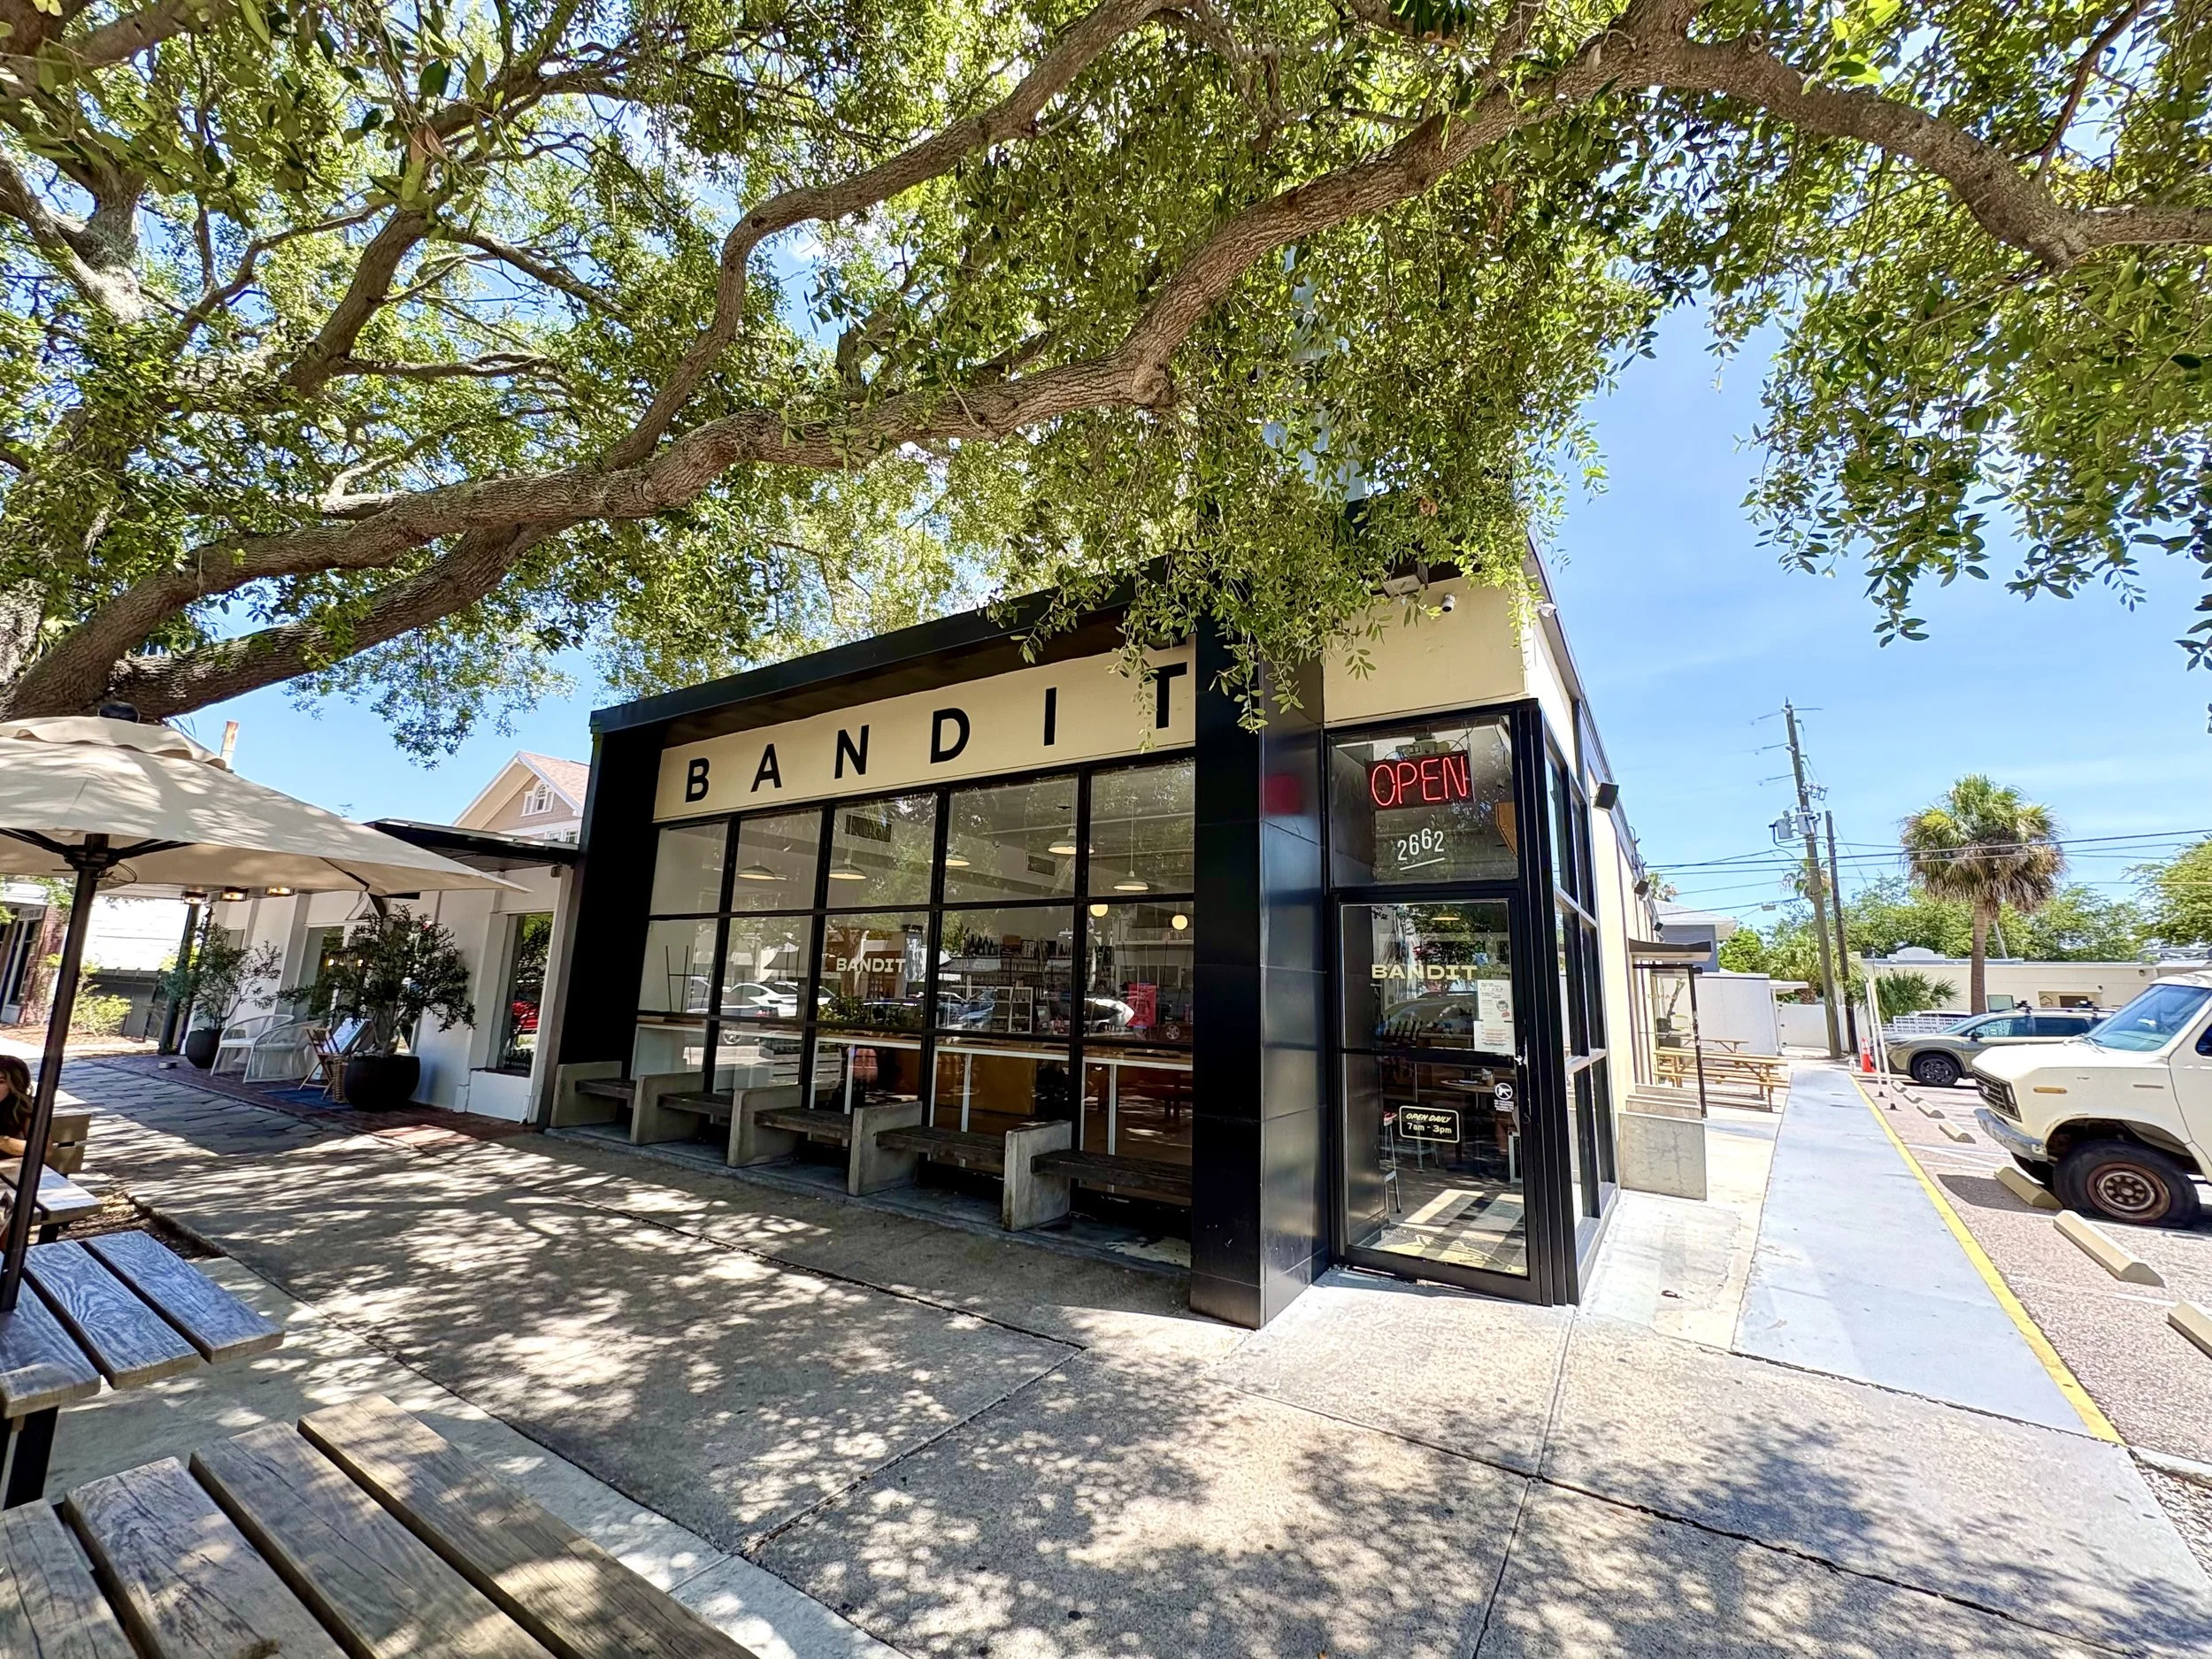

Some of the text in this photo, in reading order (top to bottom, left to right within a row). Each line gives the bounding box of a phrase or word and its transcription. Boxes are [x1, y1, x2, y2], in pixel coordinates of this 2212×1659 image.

[685, 662, 1187, 803] BANDIT
[1371, 756, 1467, 806] OPEN
[1397, 828, 1445, 861] 2662
[836, 957, 906, 973] BANDIT
[1371, 964, 1478, 980] BANDIT
[1405, 1112, 1452, 1124] OPEN DAILY
[1407, 1122, 1425, 1132] 7am
[1432, 1125, 1452, 1134] 3pm
